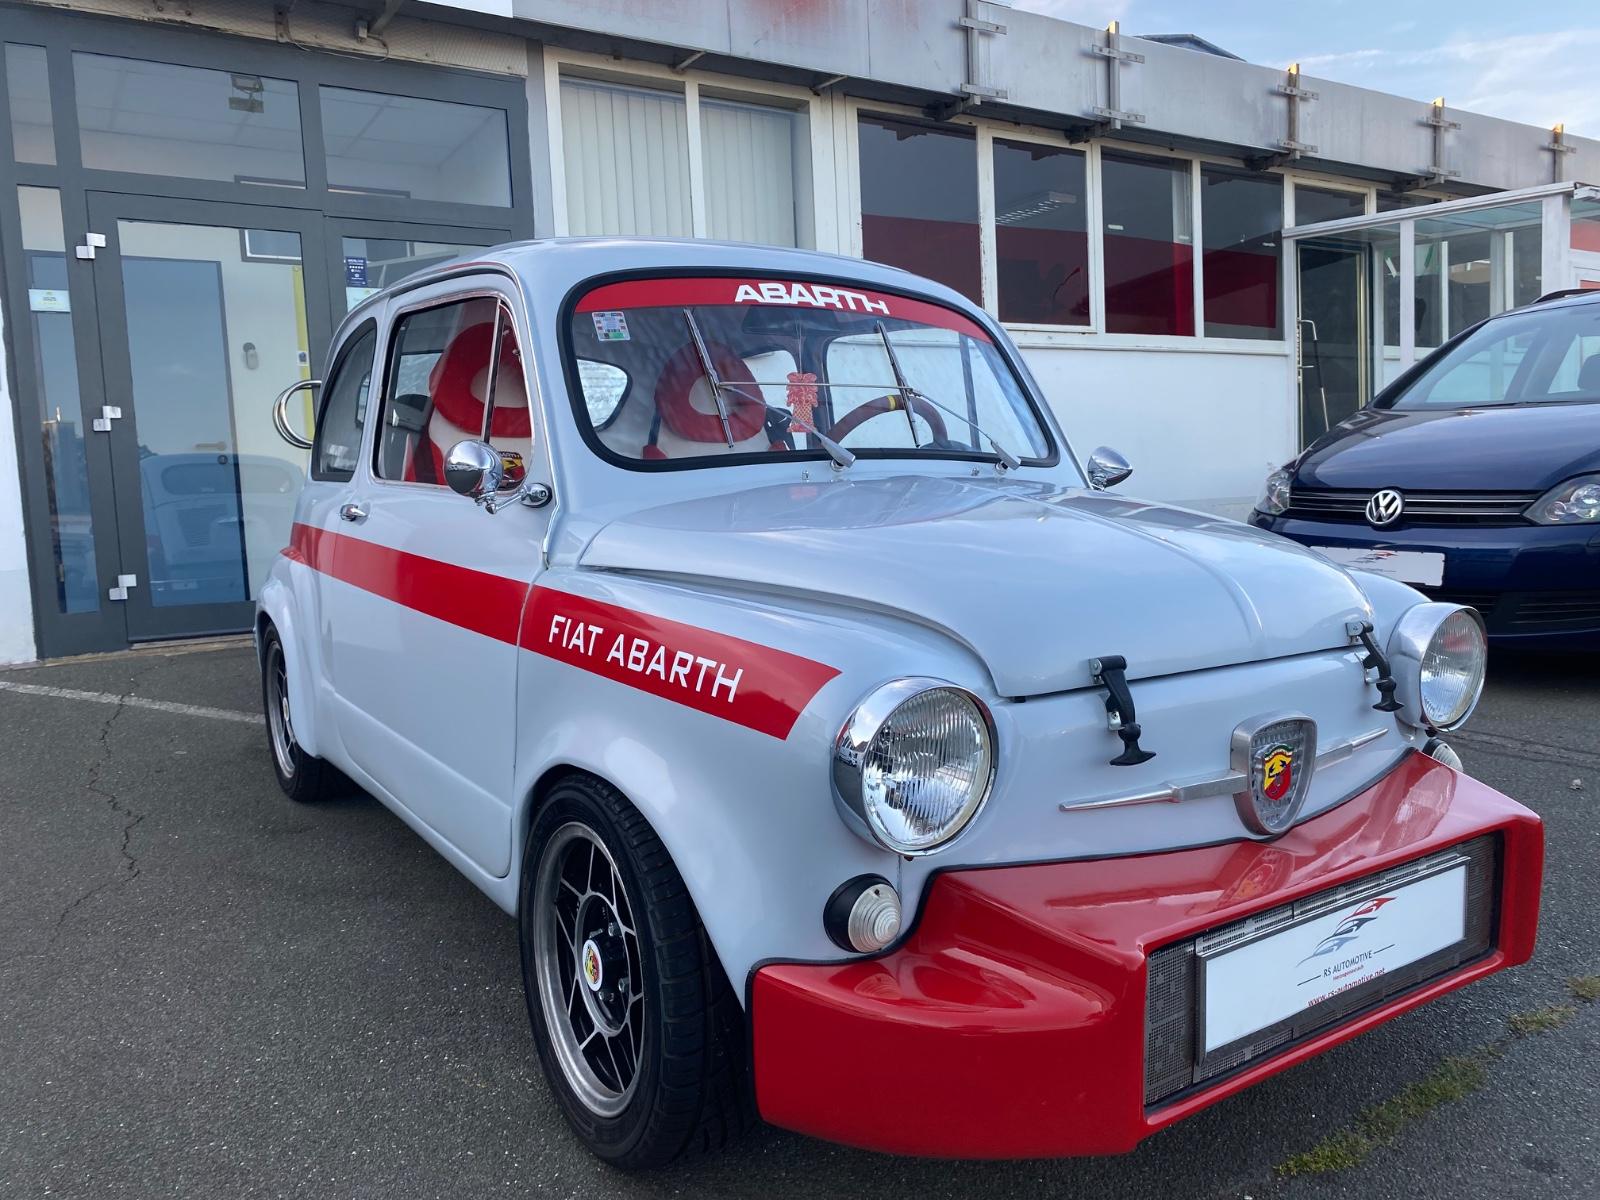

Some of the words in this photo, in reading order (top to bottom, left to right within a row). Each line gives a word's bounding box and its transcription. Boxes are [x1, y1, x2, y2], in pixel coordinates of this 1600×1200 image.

[735, 282, 890, 315] ABARTH
[1366, 490, 1402, 524] VW
[548, 614, 604, 656] FIAT
[606, 633, 743, 703] ABARTH
[1323, 967, 1332, 978] RS
[1332, 950, 1373, 974] AUTOMOTIVE
